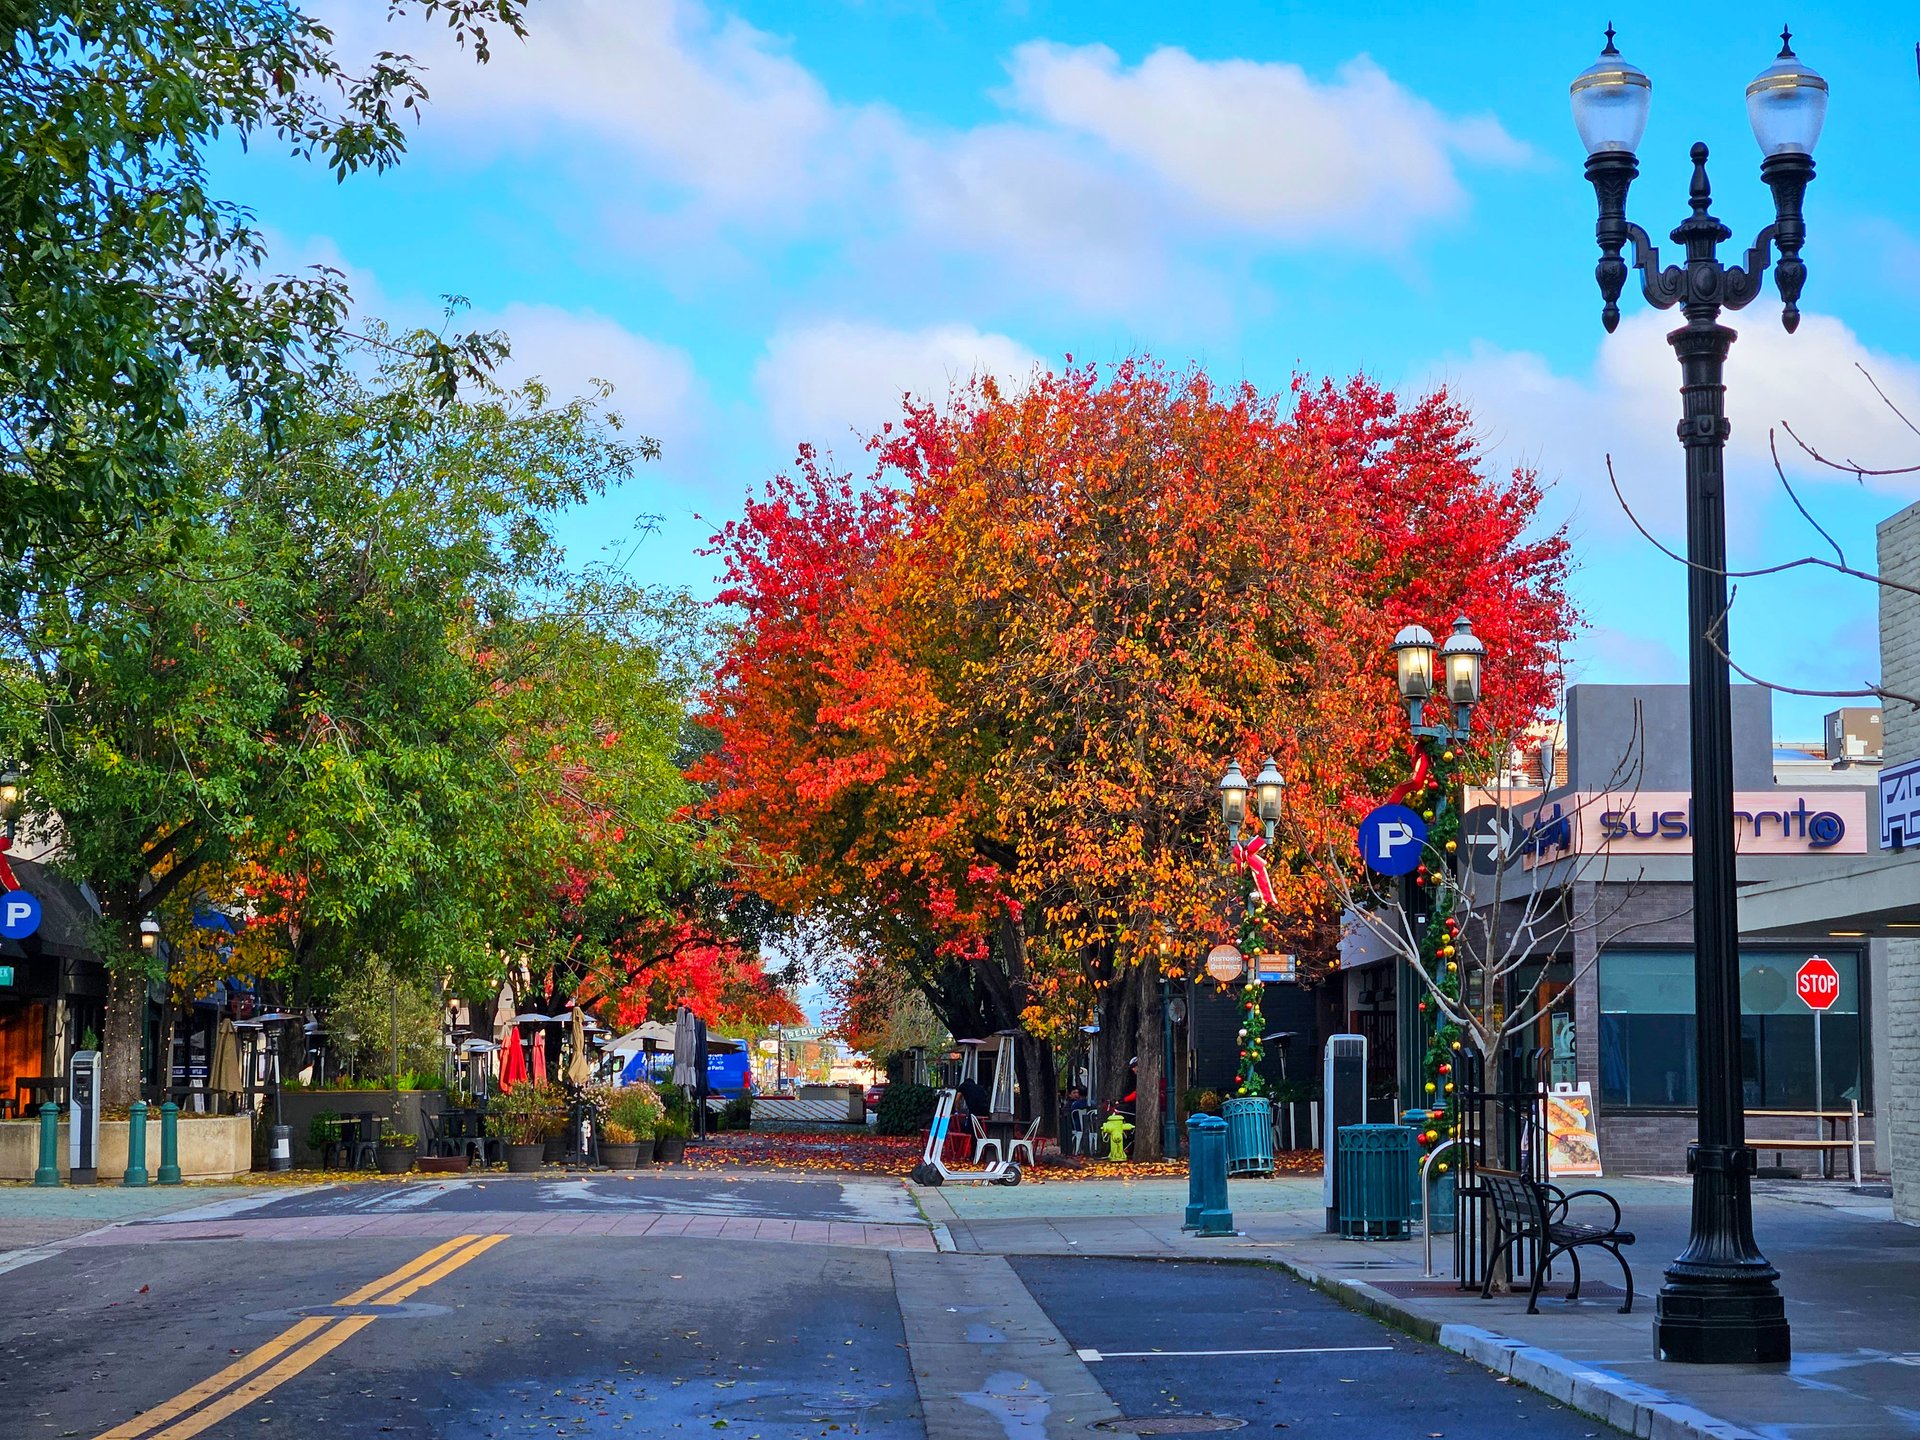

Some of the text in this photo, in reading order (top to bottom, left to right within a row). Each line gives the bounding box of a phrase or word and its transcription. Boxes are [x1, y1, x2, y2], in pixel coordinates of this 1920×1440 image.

[1378, 823, 1413, 858] P
[6, 902, 31, 926] P
[1800, 974, 1836, 993] STOP
